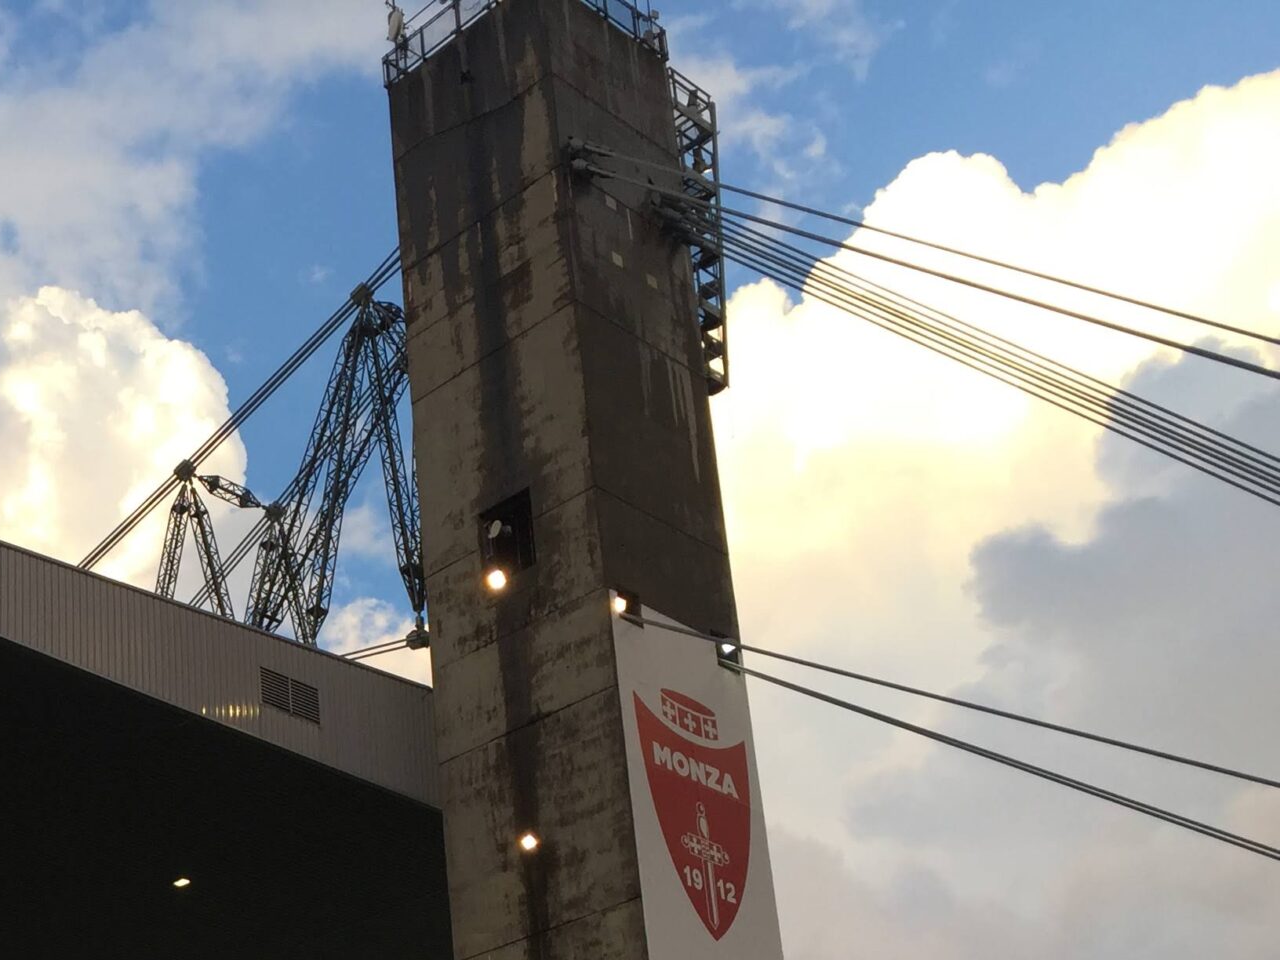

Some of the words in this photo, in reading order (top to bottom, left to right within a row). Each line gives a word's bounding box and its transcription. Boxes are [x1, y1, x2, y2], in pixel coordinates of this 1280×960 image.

[652, 741, 740, 800] MONZA
[683, 865, 703, 891] 19
[717, 879, 737, 904] 12
